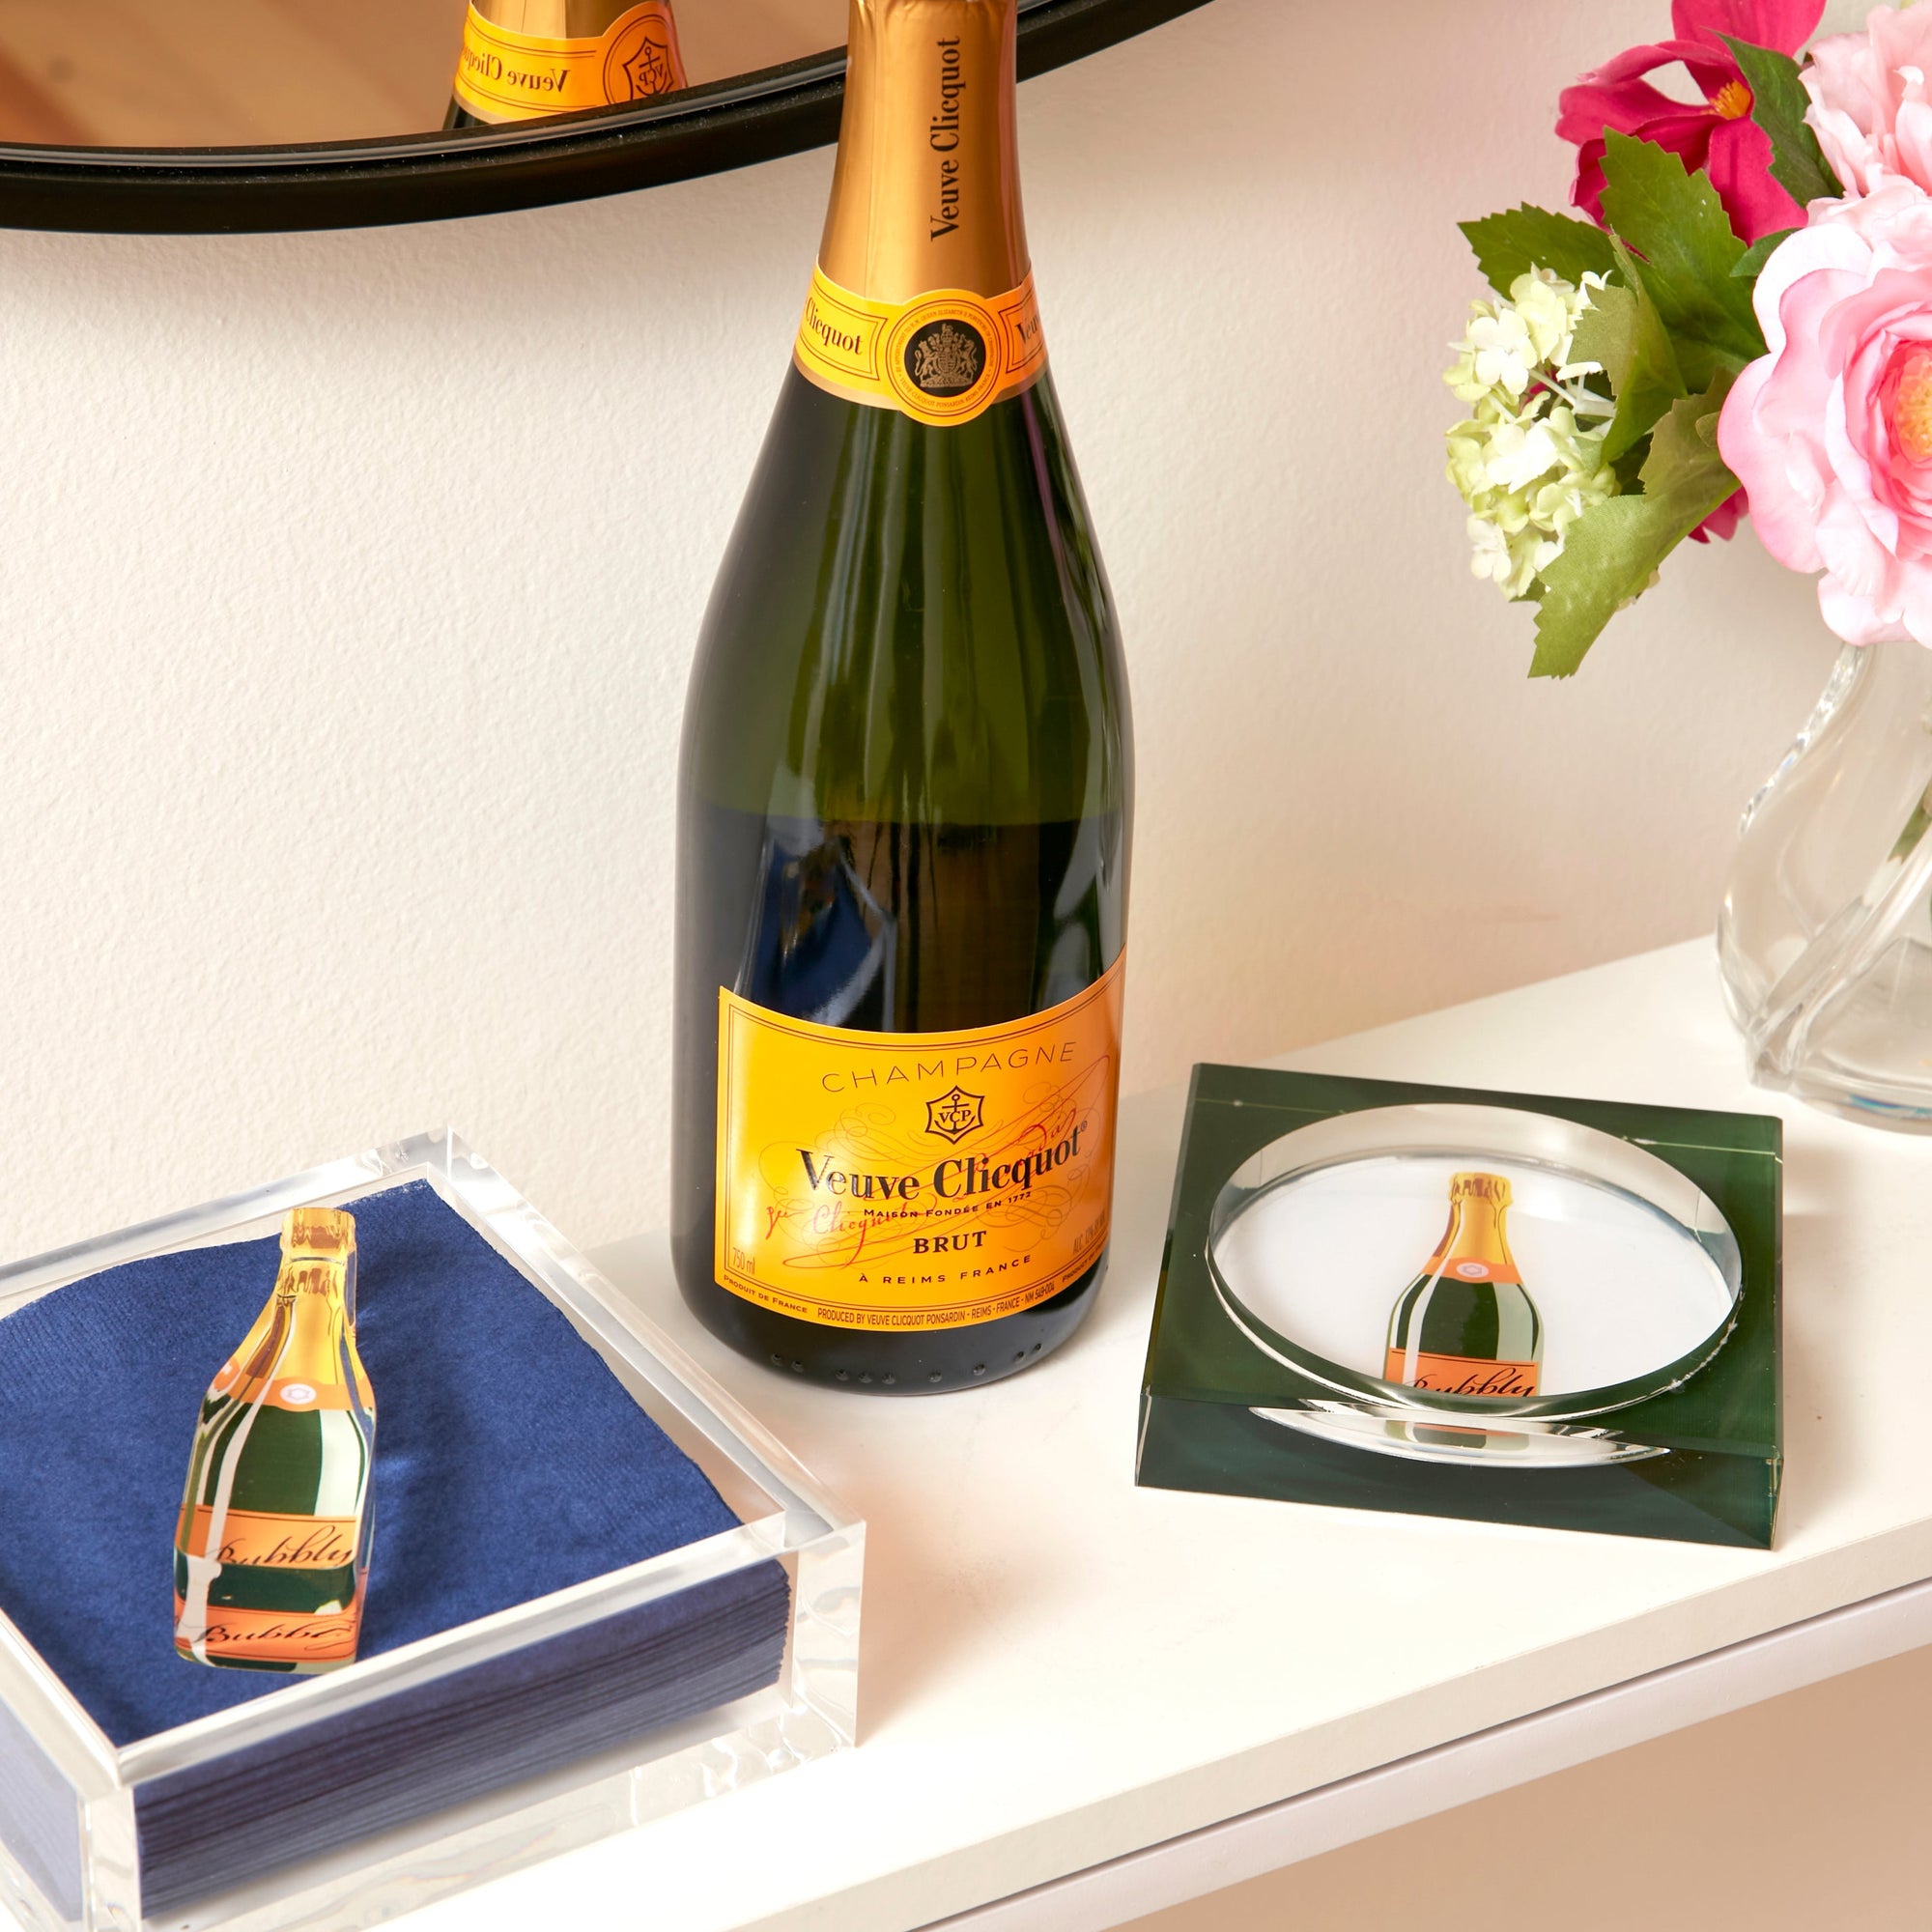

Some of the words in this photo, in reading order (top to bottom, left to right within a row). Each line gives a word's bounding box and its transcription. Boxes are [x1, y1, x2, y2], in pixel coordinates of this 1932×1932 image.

[930, 36, 966, 152] Clicquot
[930, 159, 960, 242] Veuve
[806, 297, 864, 355] Clicquot
[822, 1041, 1077, 1093] CHAMPAGNE
[938, 1109, 972, 1124] VCP
[796, 1149, 920, 1201] Veuve
[864, 1208, 918, 1218] MAISON
[986, 1200, 1002, 1209] EN
[1009, 1191, 1032, 1203] 1772
[732, 1246, 745, 1270] 750
[913, 1231, 986, 1254] BRUT
[859, 1272, 868, 1283] À
[883, 1274, 946, 1284] REIMS
[960, 1255, 1032, 1280] FRANCE
[724, 1274, 755, 1295] PRODUIT
[758, 1293, 770, 1302] DE
[772, 1297, 809, 1313] FRANCE
[817, 1307, 855, 1322] PRODUCED
[856, 1313, 866, 1323] BY
[867, 1314, 890, 1325] VEUVE
[892, 1314, 924, 1325] CLICQUOT
[925, 1310, 966, 1324] PONSARDIN
[971, 1305, 992, 1319] REIMS
[996, 1296, 1020, 1314] FRANCE
